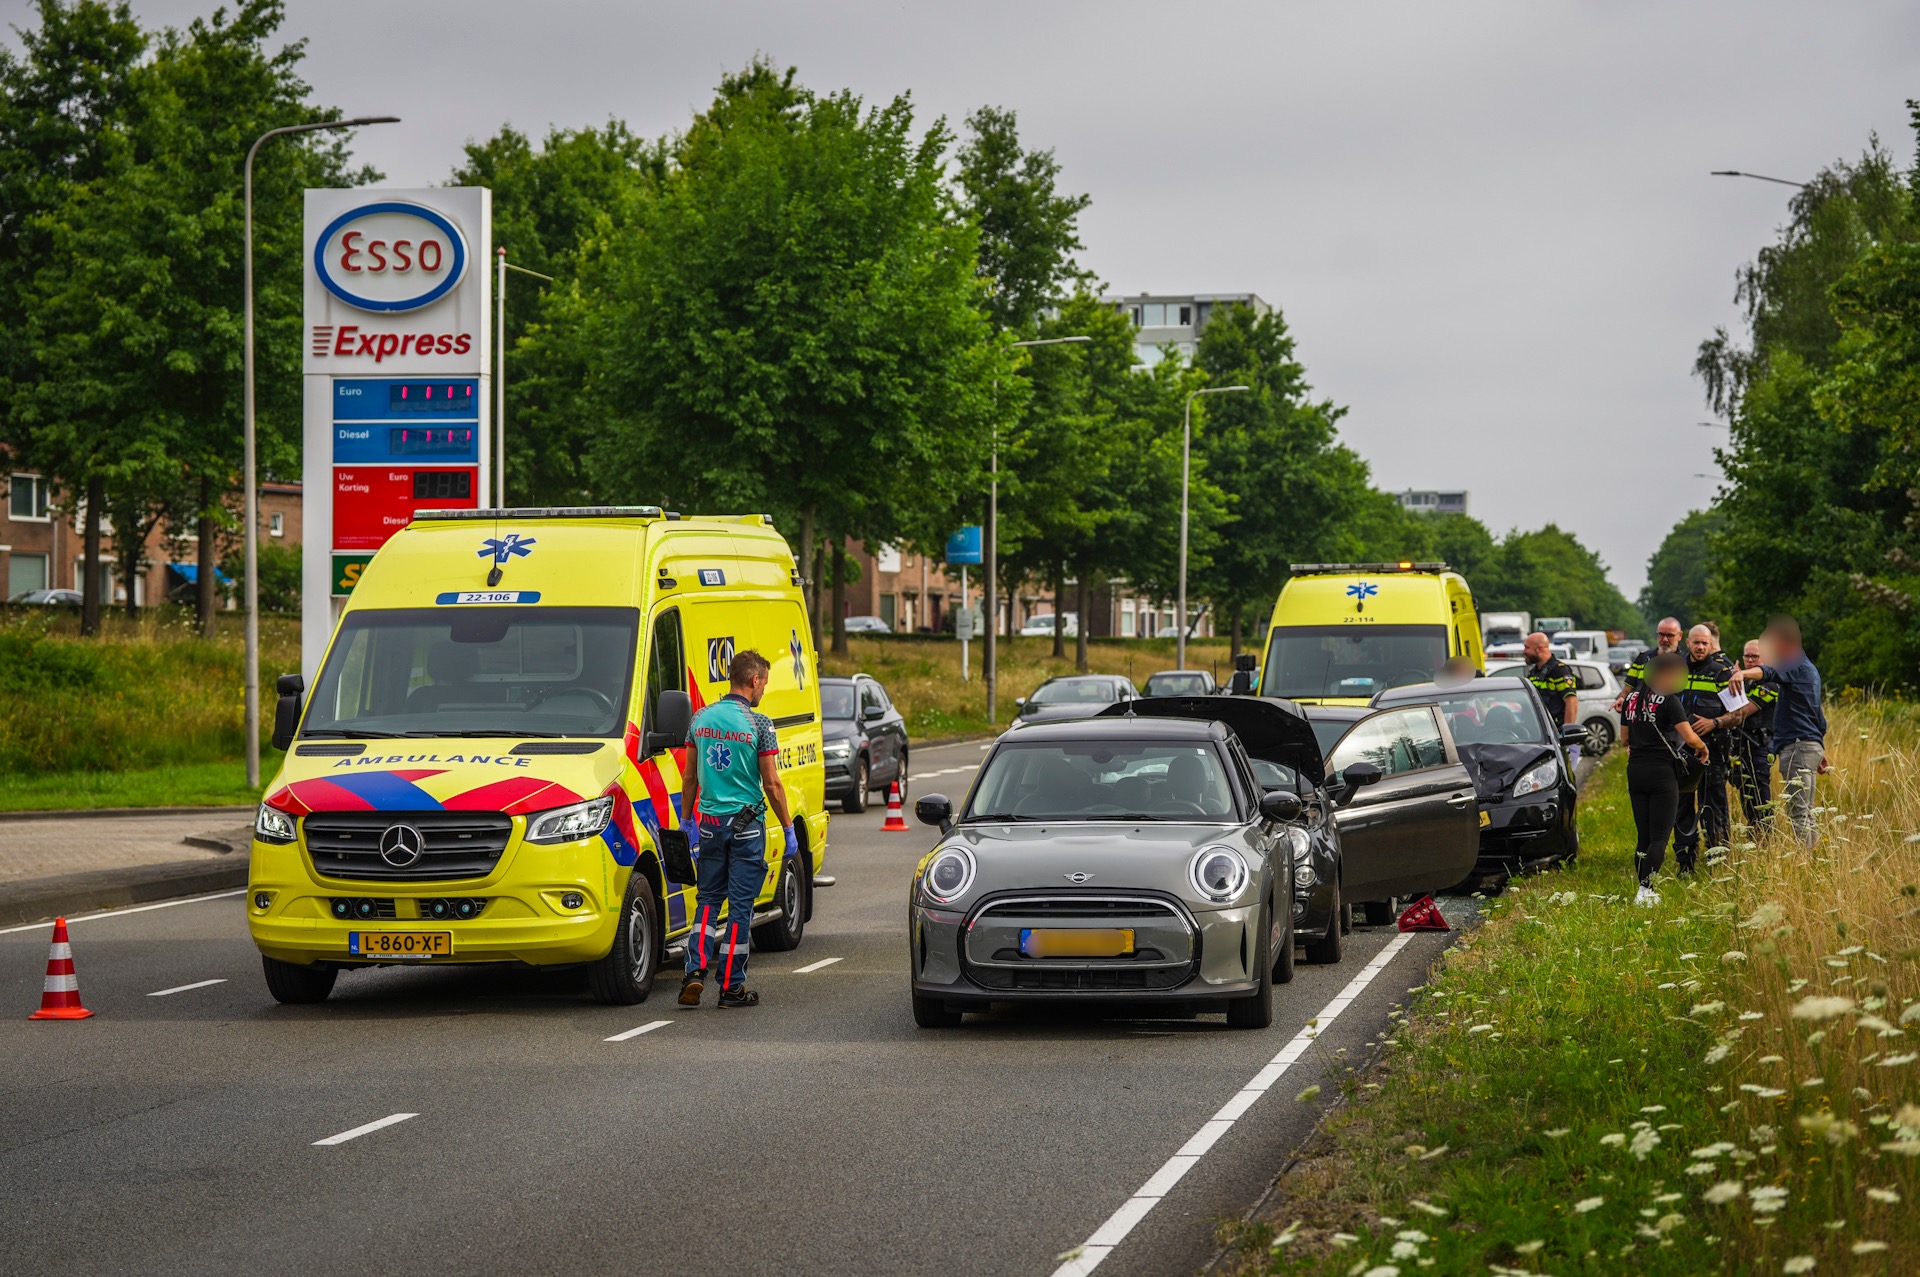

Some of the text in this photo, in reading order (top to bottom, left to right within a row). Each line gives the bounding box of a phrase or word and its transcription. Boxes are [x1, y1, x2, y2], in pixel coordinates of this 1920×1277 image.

[334, 326, 472, 363] Express
[339, 387, 362, 396] Euro
[339, 430, 369, 439] Diesel
[339, 473, 409, 481] Uw Euro
[339, 484, 370, 493] Korting
[383, 516, 409, 525] Diesel
[465, 593, 511, 602] 22-106
[694, 727, 753, 744] AMBULANCE
[797, 743, 817, 766] 22-106
[332, 755, 533, 768] AMBULANCE
[365, 936, 443, 951] L-860-XF
